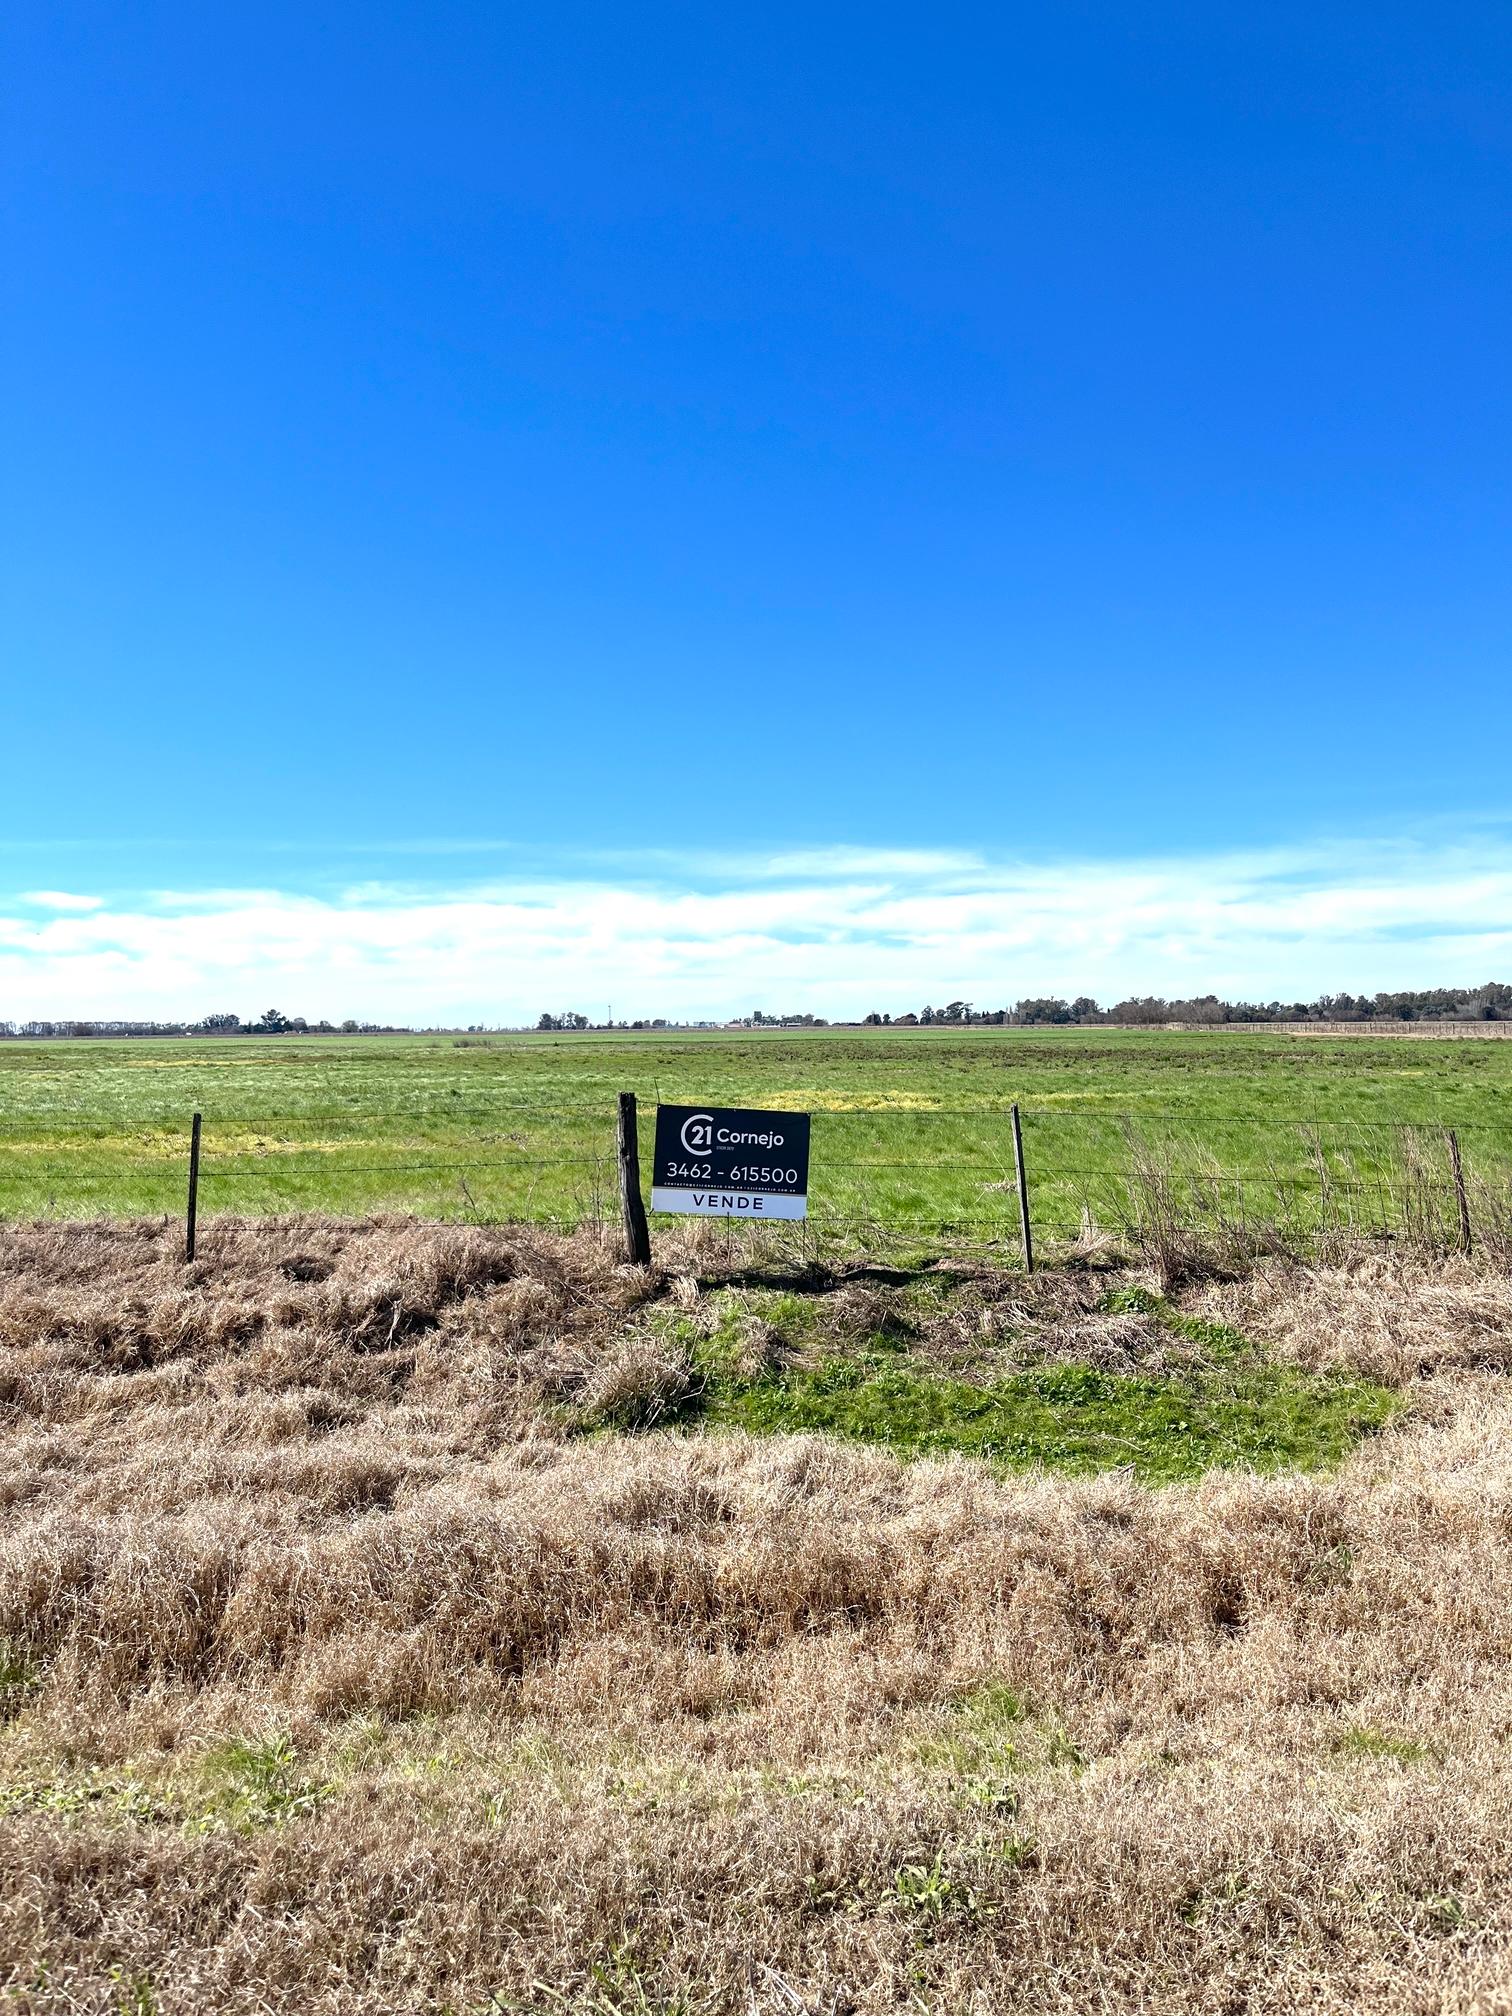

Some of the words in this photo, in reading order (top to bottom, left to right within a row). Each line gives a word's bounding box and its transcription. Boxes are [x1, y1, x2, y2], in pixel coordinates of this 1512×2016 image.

[717, 1128, 784, 1149] Cornejo
[667, 1162, 711, 1179] 3462
[730, 1166, 798, 1184] 615500
[692, 1194, 764, 1209] VENDE
